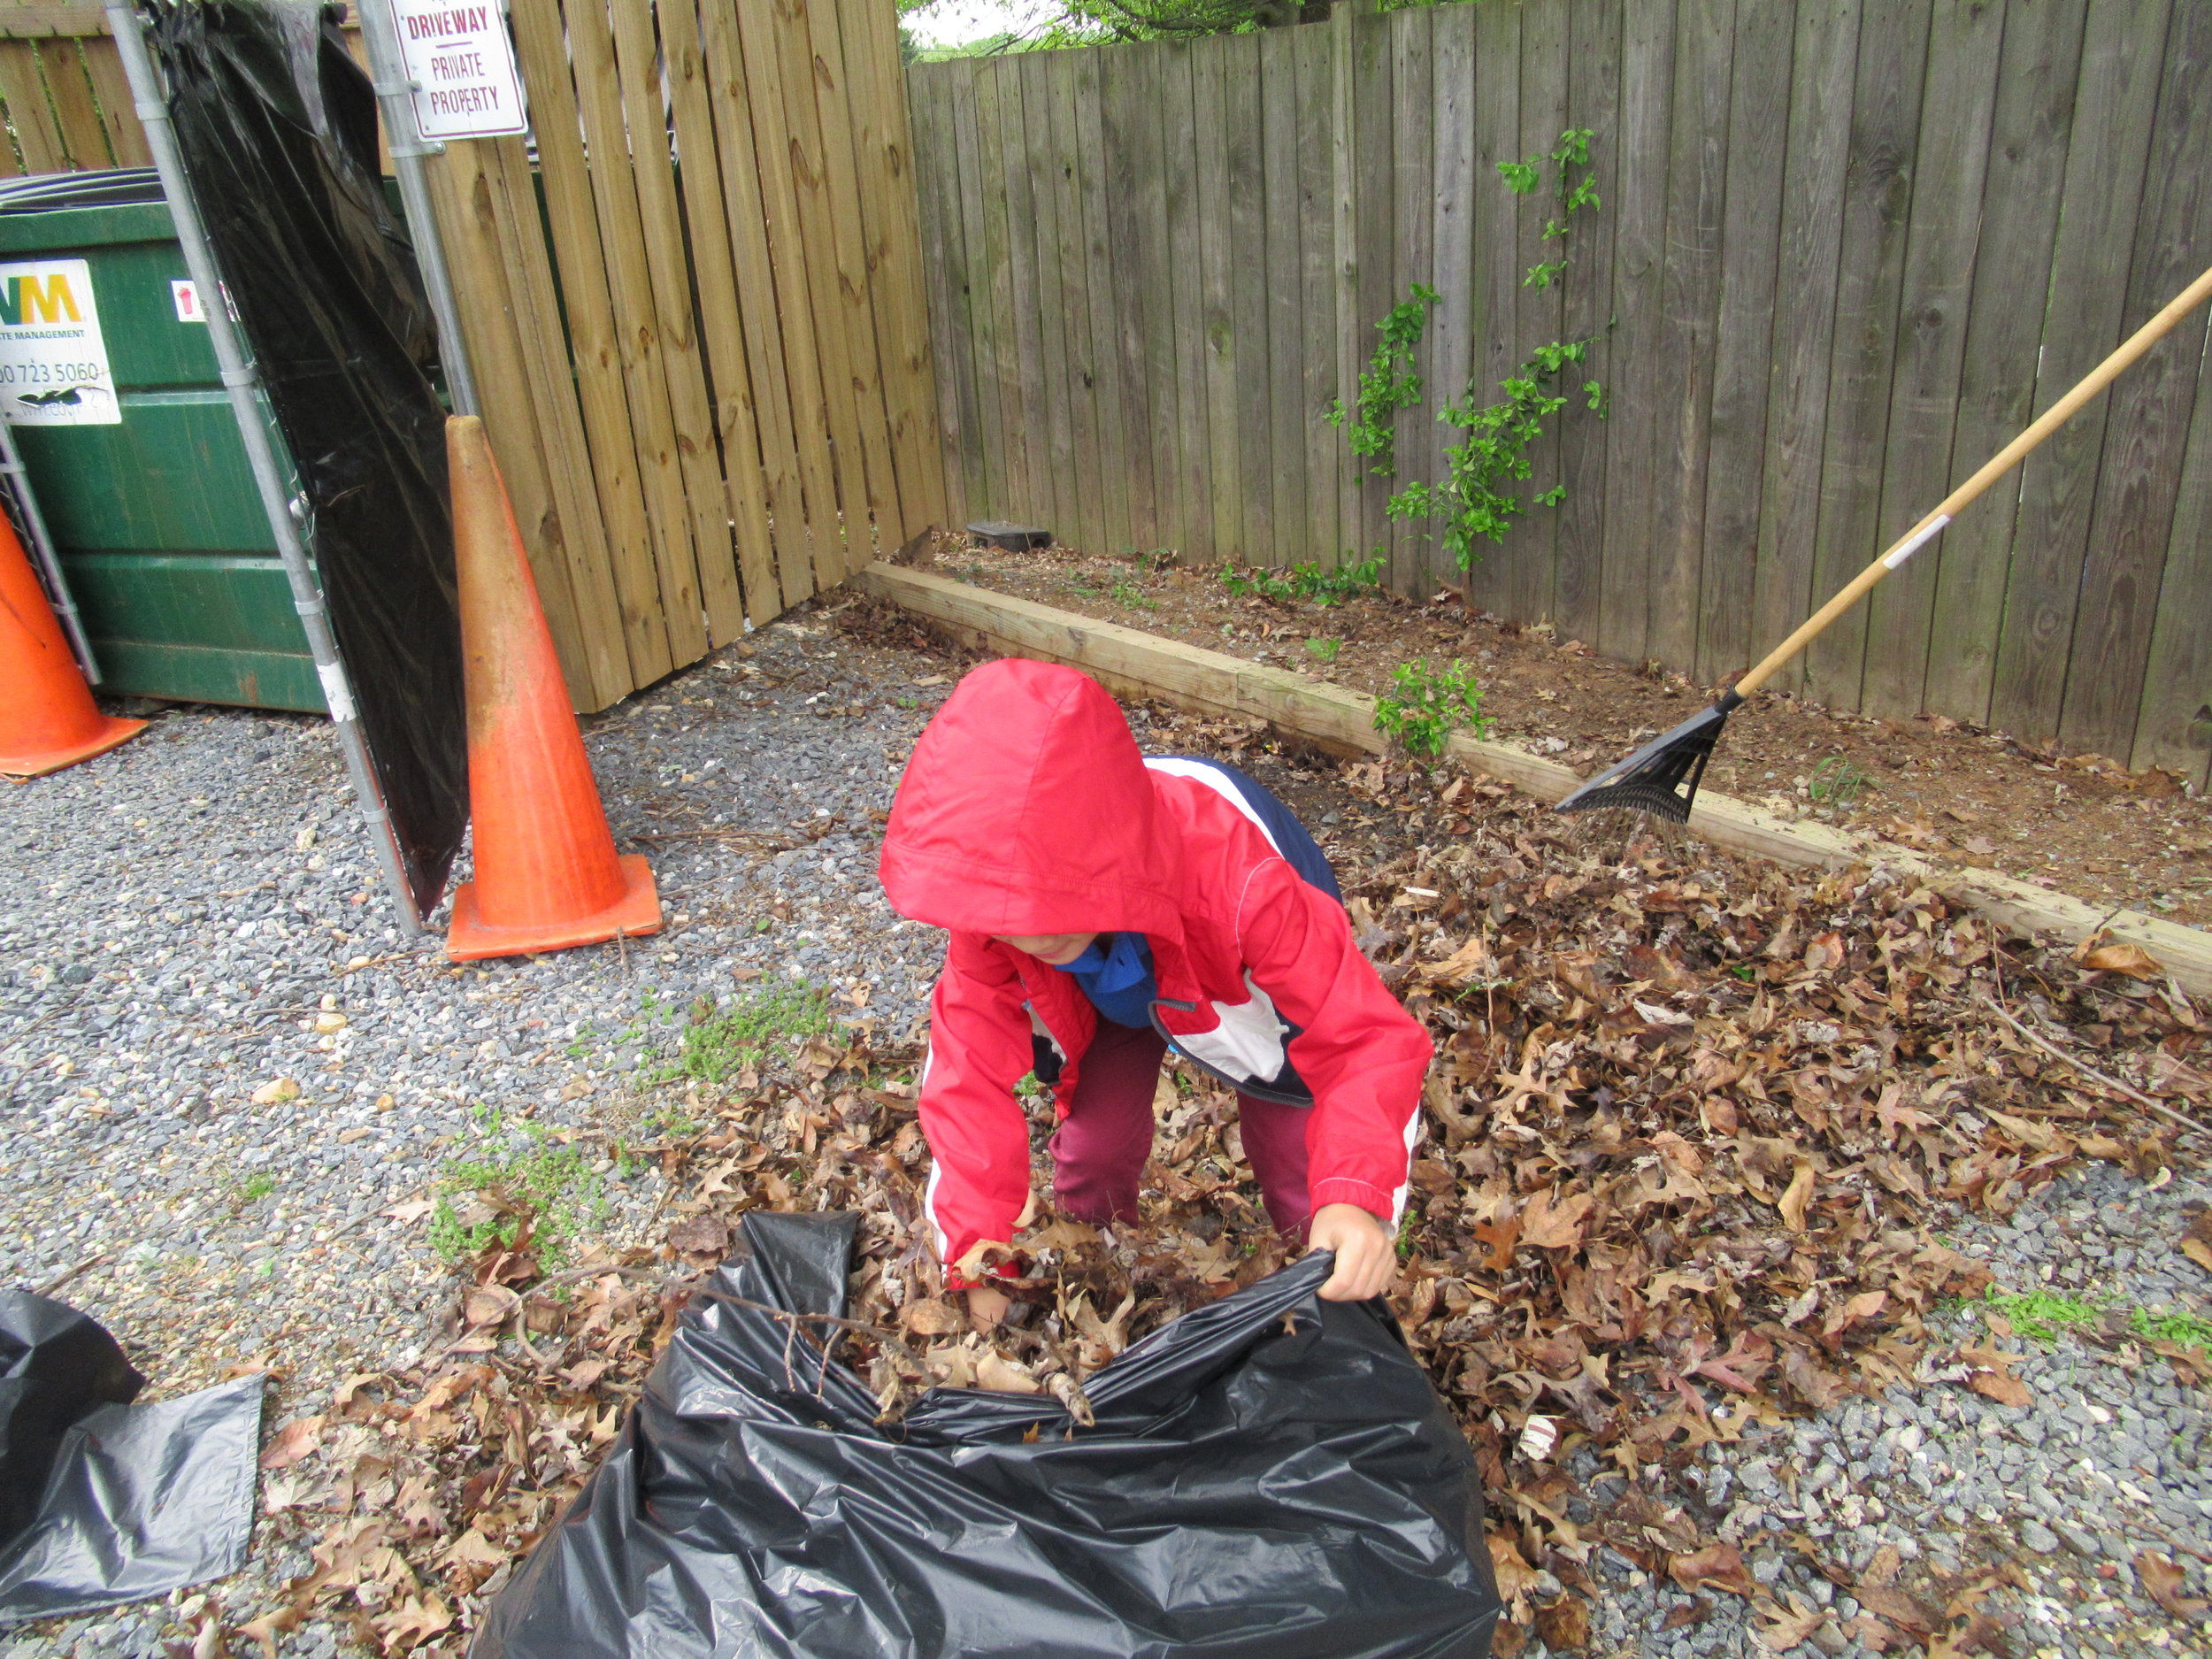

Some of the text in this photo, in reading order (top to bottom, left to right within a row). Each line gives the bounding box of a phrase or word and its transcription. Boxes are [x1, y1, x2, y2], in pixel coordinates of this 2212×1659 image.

[407, 6, 488, 40] DRIVEWAY
[431, 52, 486, 81] PRIVATE
[430, 86, 499, 115] PROPERTY
[0, 329, 85, 341] TE MANAGEMENT
[17, 363, 50, 383] 723
[55, 362, 98, 382] 5060
